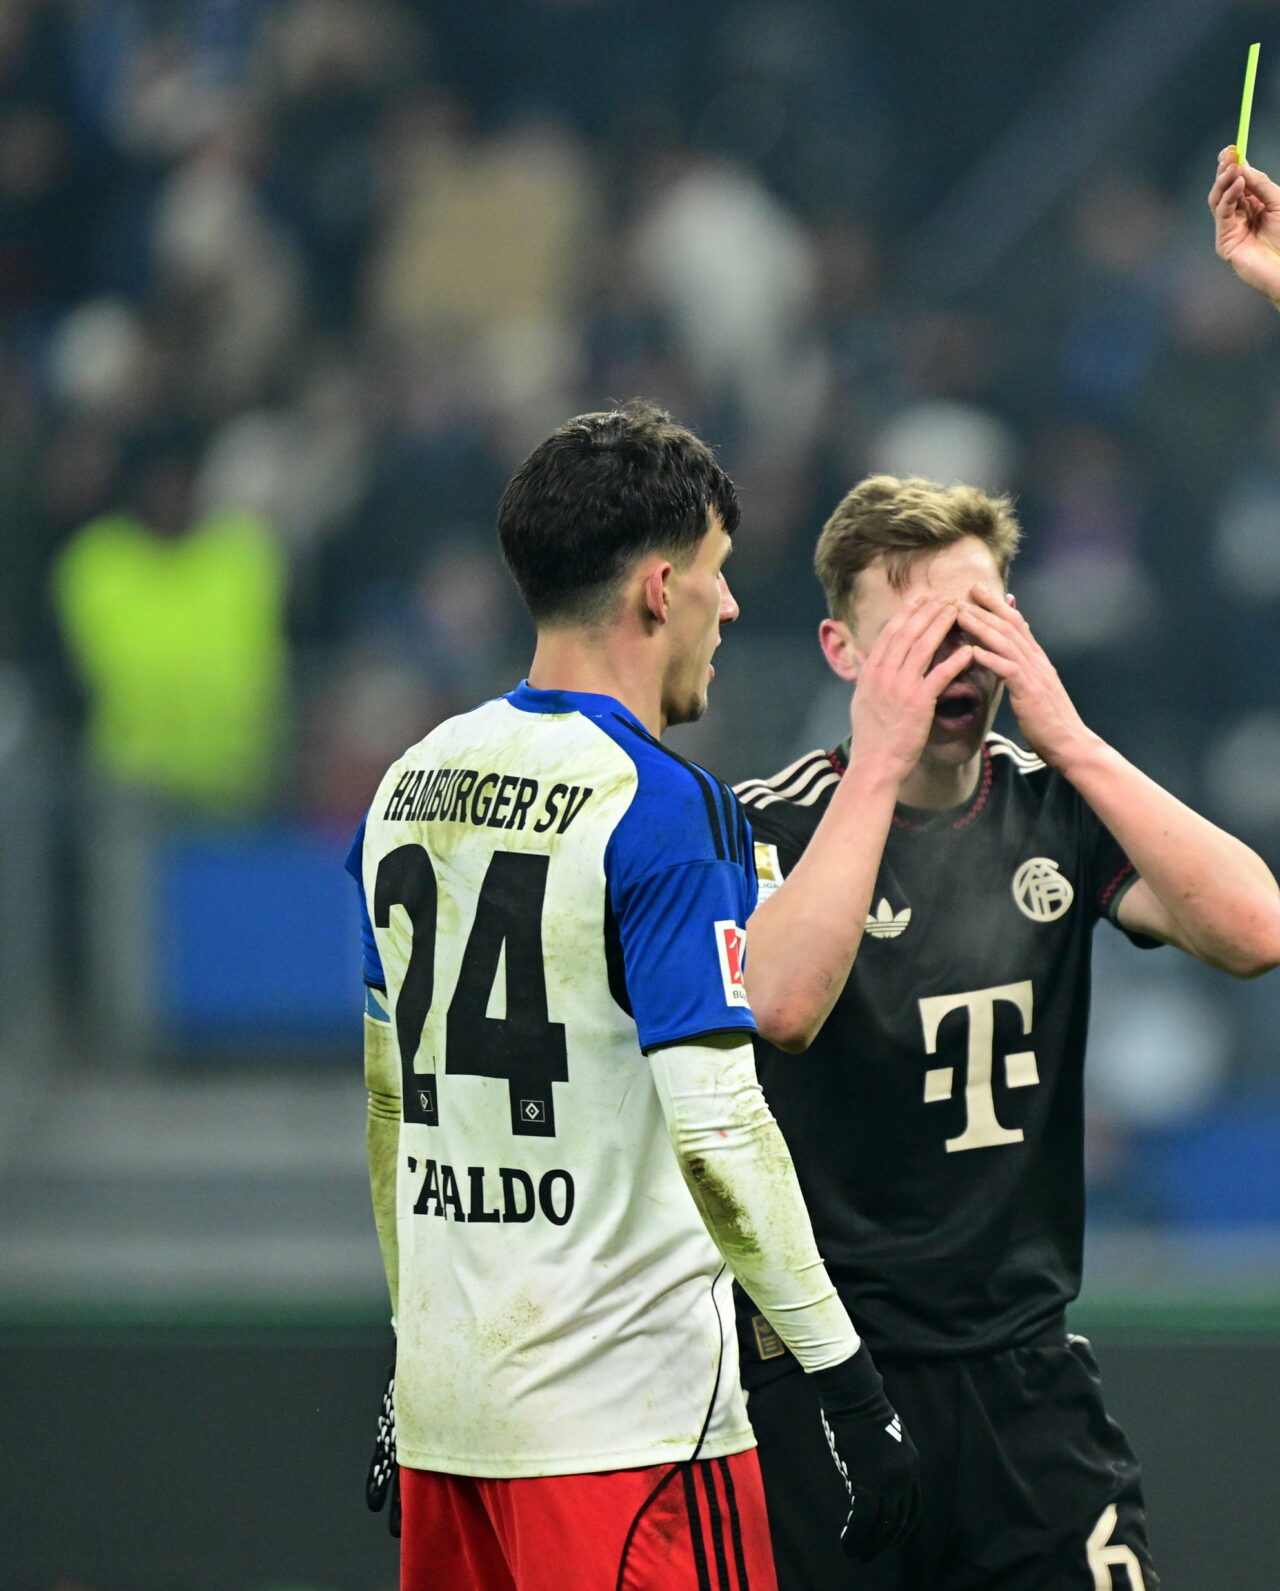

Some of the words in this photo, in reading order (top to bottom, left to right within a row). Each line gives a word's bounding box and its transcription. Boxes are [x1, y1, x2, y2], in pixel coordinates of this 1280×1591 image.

[383, 769, 538, 830] HAMBURGER
[533, 783, 593, 834] SV
[374, 843, 569, 1138] 24
